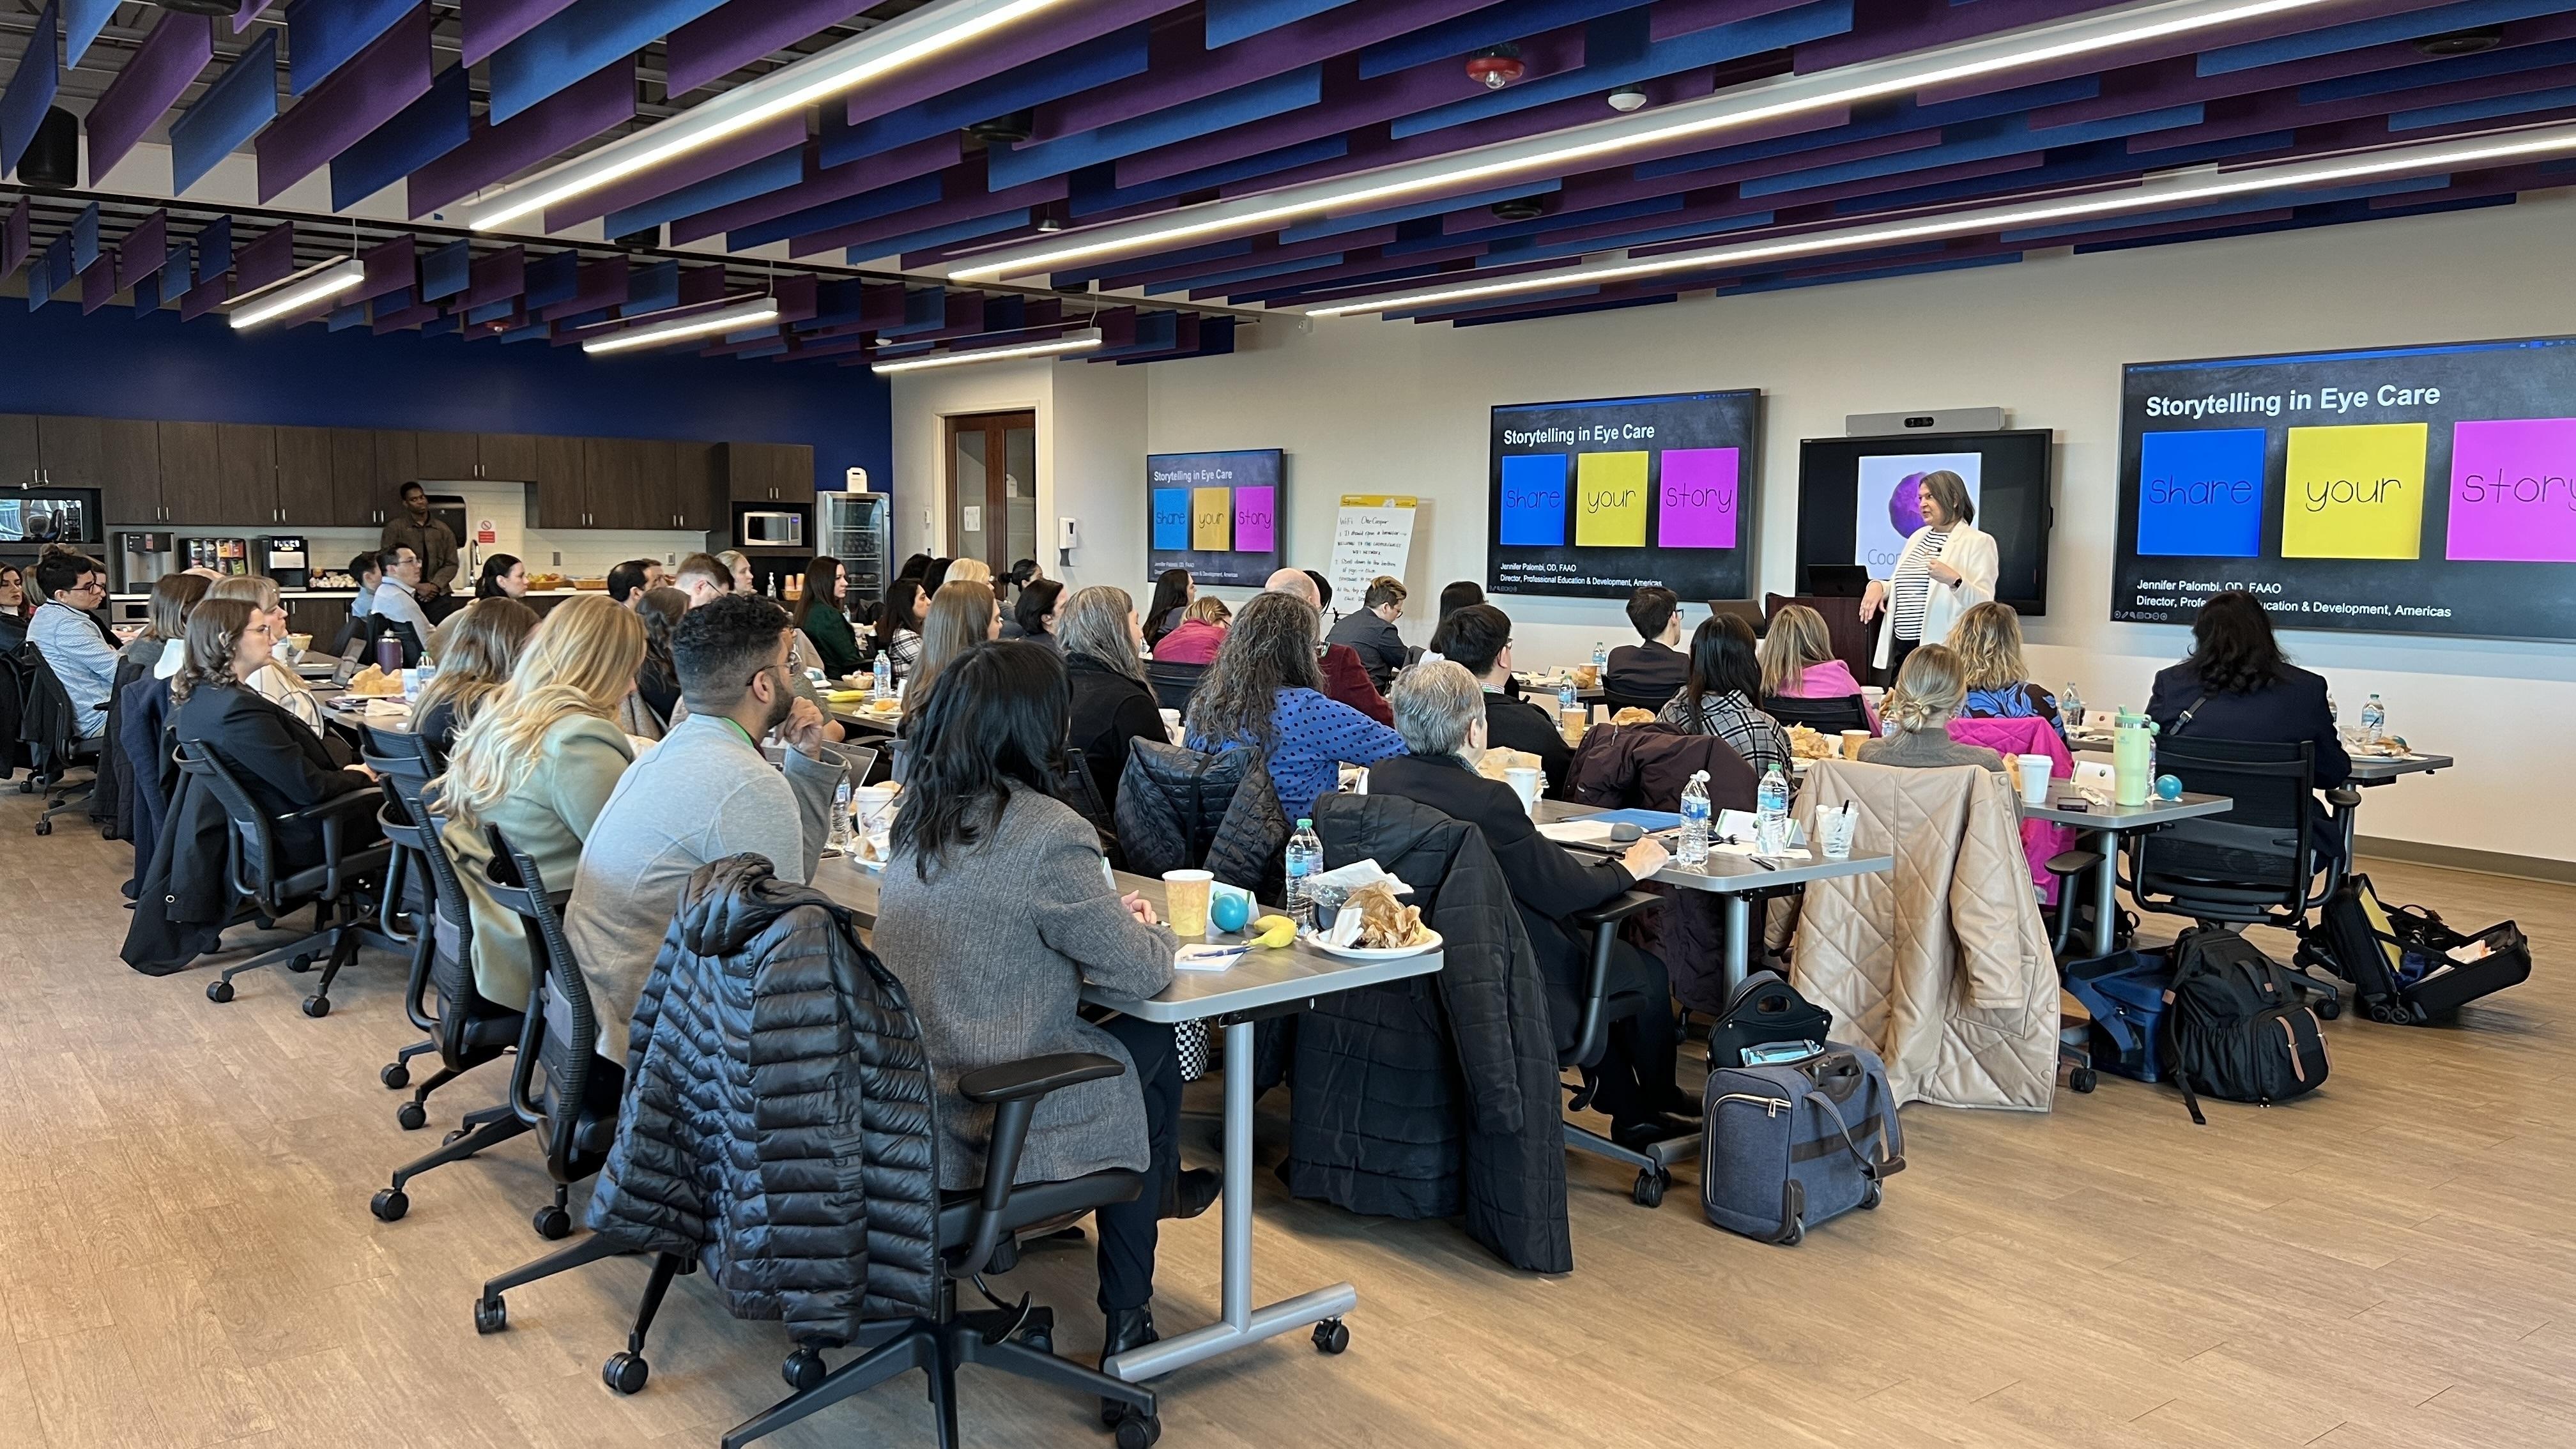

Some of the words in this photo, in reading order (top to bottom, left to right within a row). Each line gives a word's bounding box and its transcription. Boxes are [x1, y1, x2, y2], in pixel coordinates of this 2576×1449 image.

[2146, 392, 2281, 420] Storytelling
[2288, 390, 2312, 411] in
[2320, 387, 2368, 414] Eye
[2377, 385, 2441, 406] Care
[1504, 427, 1575, 447] Storytelling
[1579, 426, 1590, 441] in
[1595, 425, 1619, 443] Eye
[1623, 424, 1655, 440] Care
[1154, 470, 1192, 483] Storytelling
[1193, 470, 1200, 480] in
[1201, 469, 1215, 482] Eye
[1216, 468, 1232, 480] Care
[1506, 486, 1561, 509] share
[1665, 482, 1733, 514] story
[2149, 474, 2253, 505] share
[2305, 477, 2402, 512] your
[1587, 489, 1636, 514] your
[1156, 509, 1186, 525] share
[1199, 512, 1224, 529] your
[1238, 509, 1272, 530] story
[1559, 564, 1577, 572] FAAO
[1500, 574, 1522, 583] Director,
[1523, 574, 1556, 583] Professional
[1557, 576, 1585, 585] Education
[1592, 578, 1632, 586] Development,
[2137, 579, 2176, 590] Jennifer
[2249, 583, 2282, 594] FAAO
[2136, 595, 2177, 608] Director,
[2301, 601, 2310, 611] &
[2313, 601, 2391, 616] Development,
[2395, 604, 2451, 617] Americas
